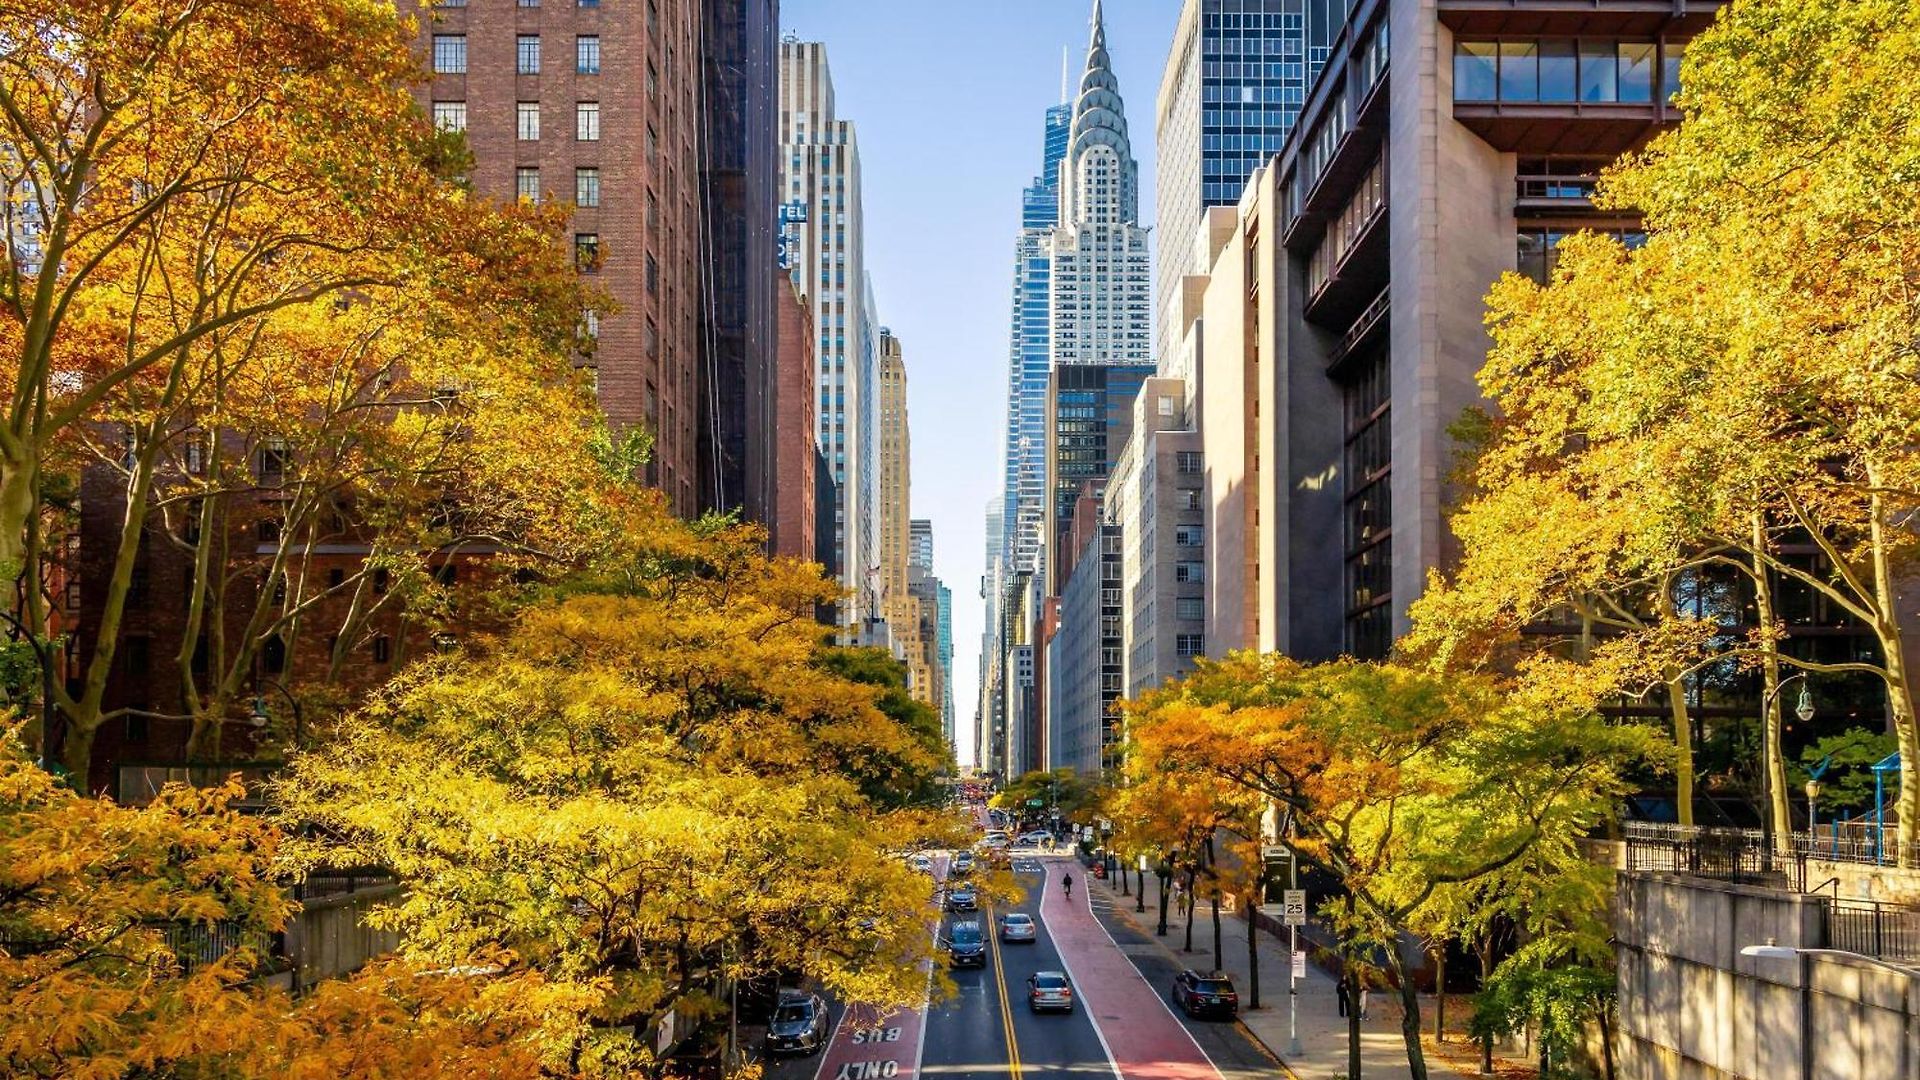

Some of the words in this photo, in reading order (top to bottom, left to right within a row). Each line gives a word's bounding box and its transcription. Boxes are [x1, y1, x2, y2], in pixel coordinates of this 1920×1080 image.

[1287, 904, 1303, 914] 25
[852, 1027, 902, 1045] BUS
[836, 1060, 898, 1080] ONLY
